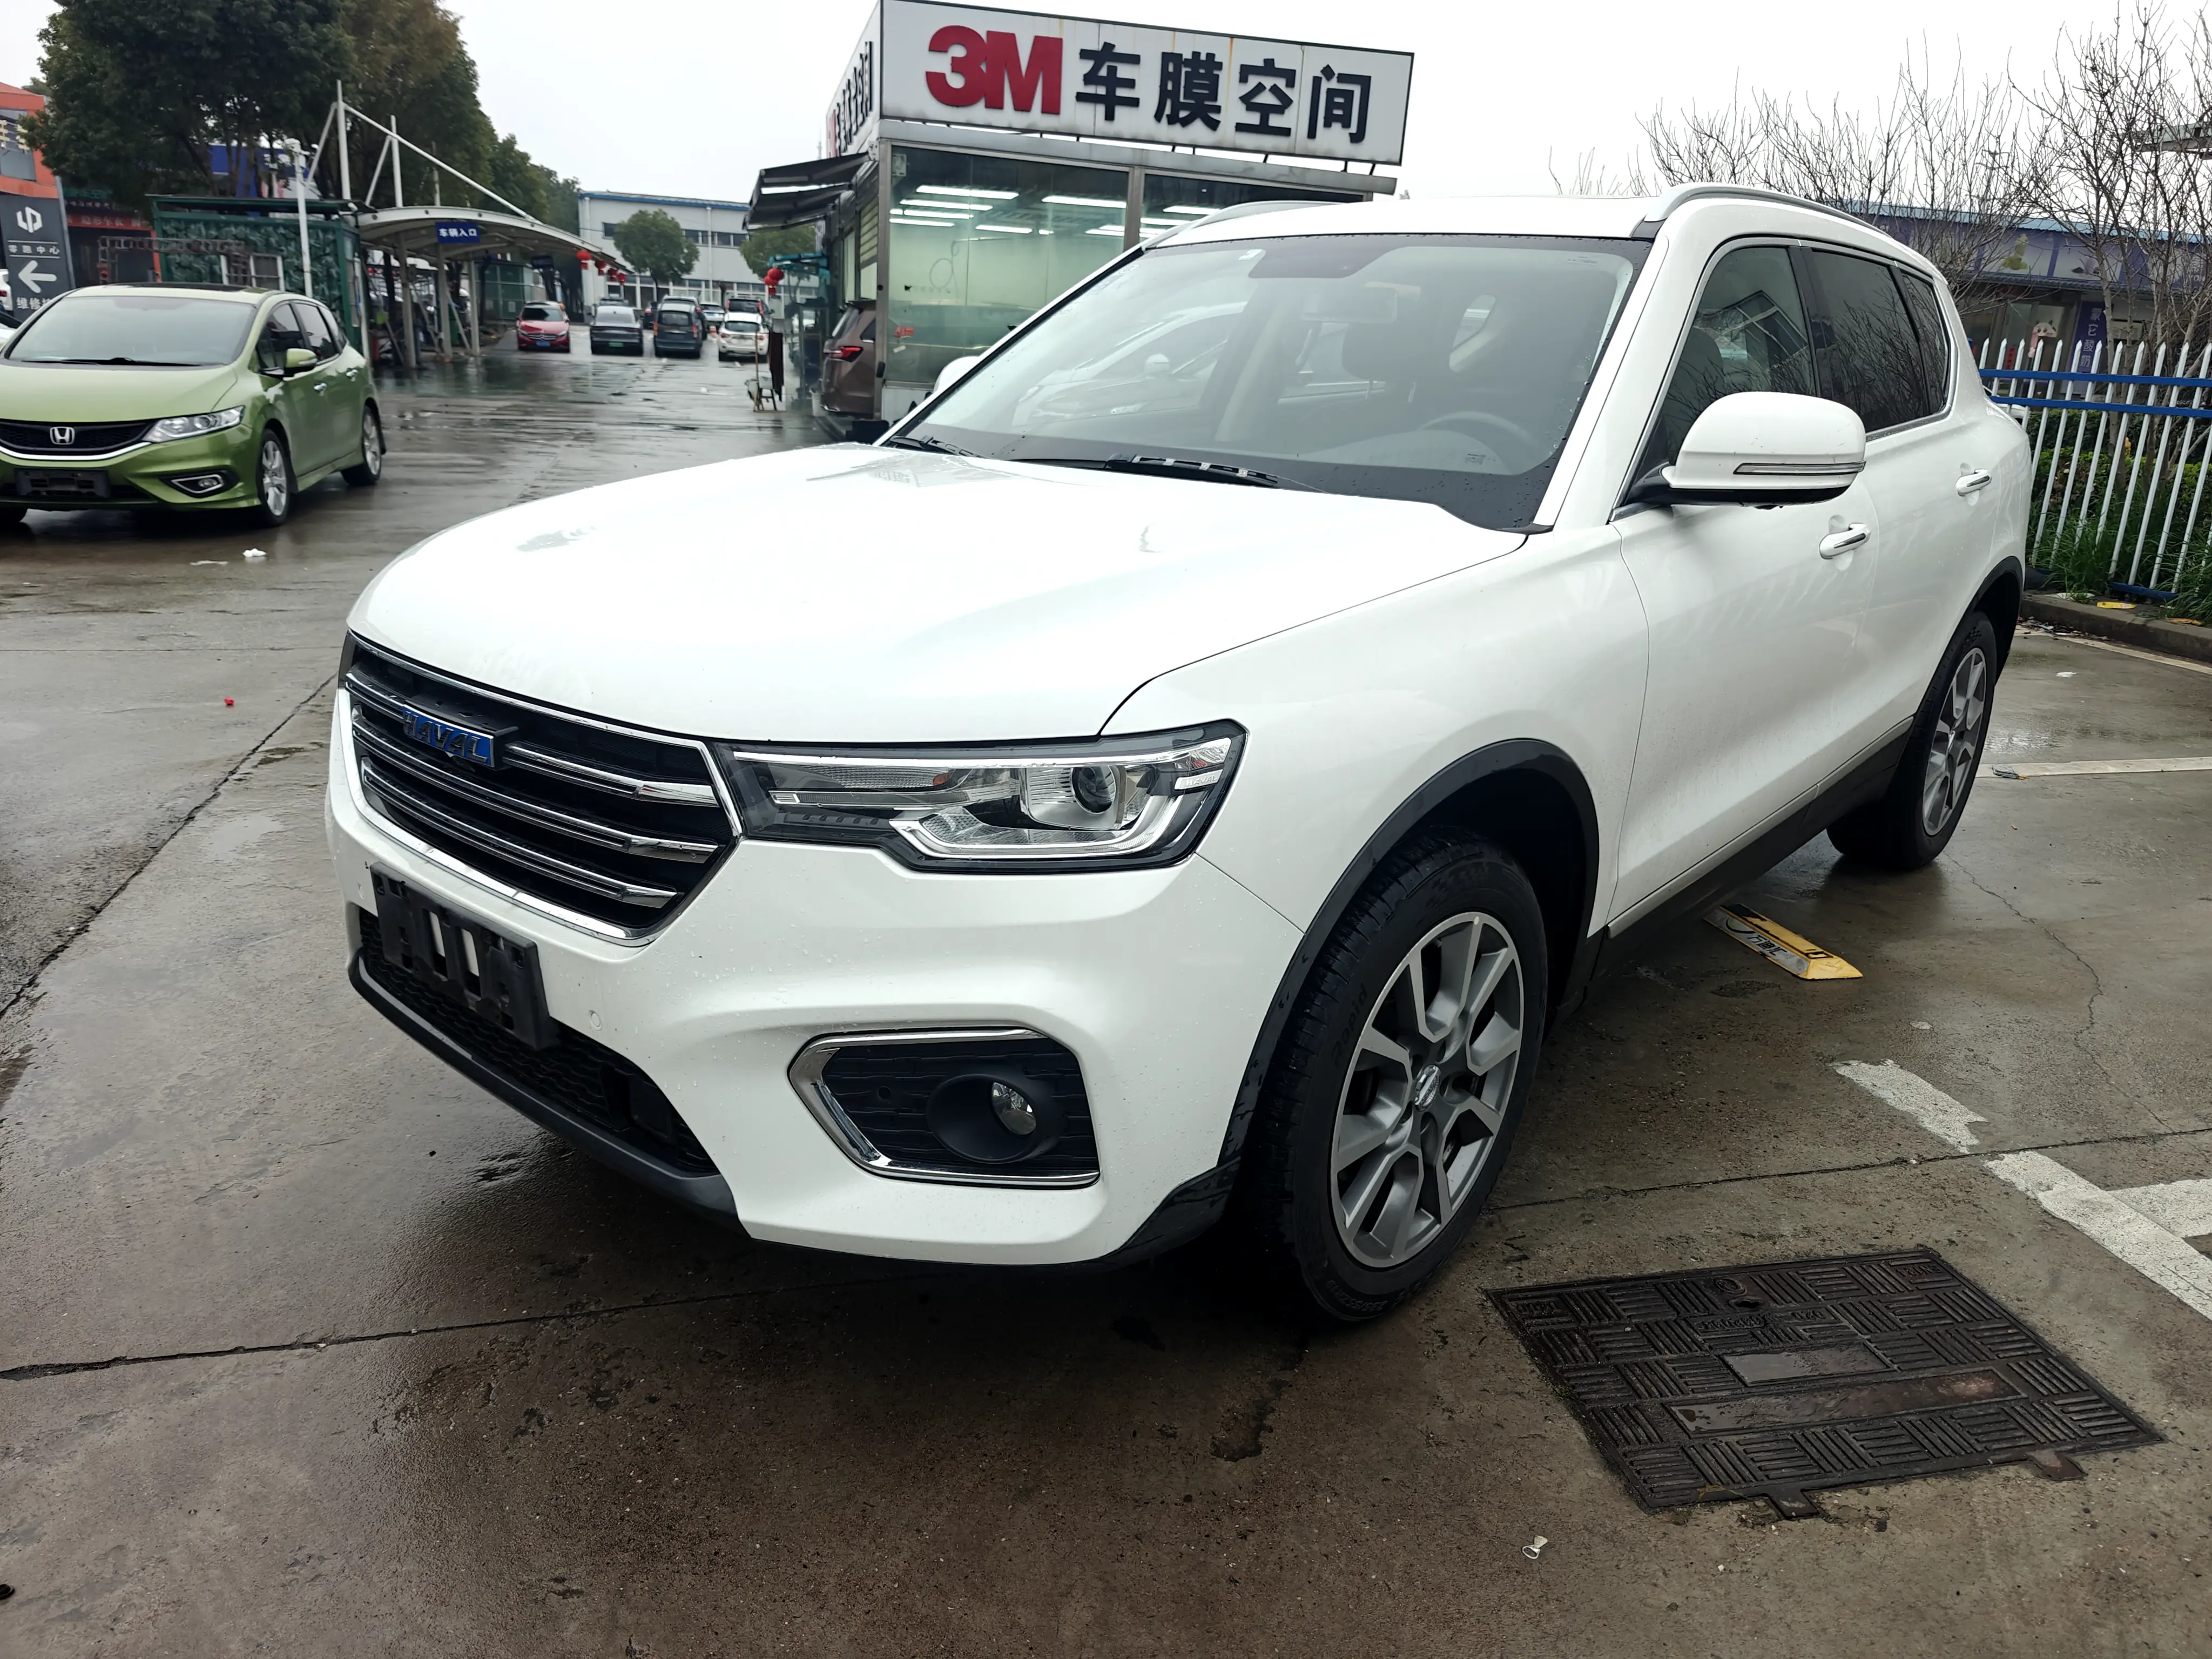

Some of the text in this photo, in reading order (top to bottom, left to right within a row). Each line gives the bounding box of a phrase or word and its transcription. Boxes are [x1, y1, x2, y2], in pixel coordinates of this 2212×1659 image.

[925, 25, 1063, 115] 3M
[1075, 41, 1372, 144] 车膜空间
[439, 228, 477, 237] 车辆入口
[404, 711, 488, 763] HAVAL
[1185, 774, 1218, 787] HAVAL
